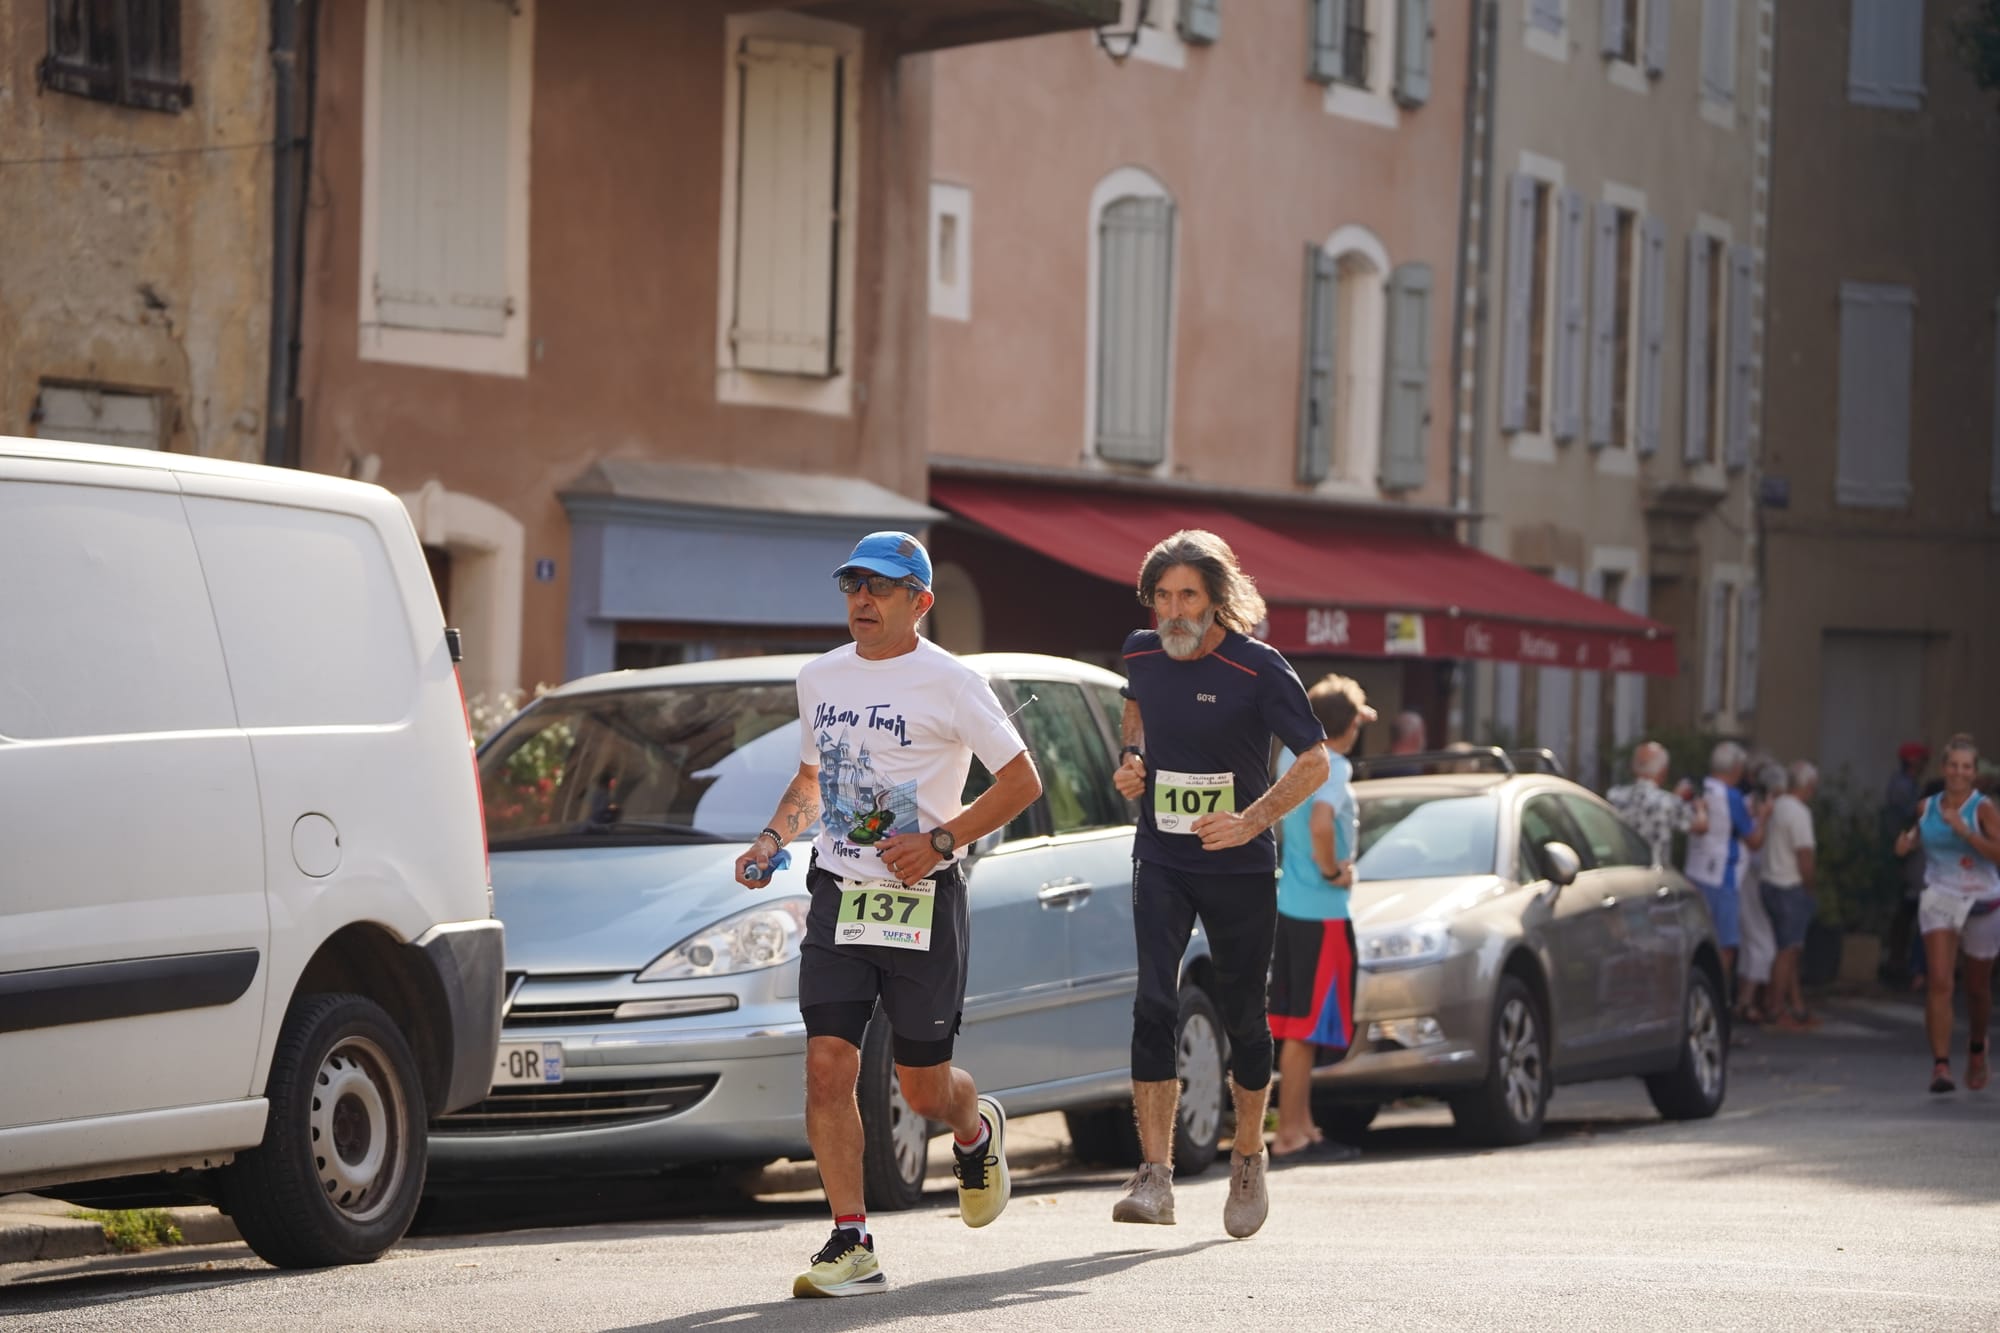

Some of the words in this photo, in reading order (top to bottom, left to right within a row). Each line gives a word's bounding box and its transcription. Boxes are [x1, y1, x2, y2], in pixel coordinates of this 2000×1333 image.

[1306, 608, 1349, 646] BAR
[1196, 693, 1217, 703] GORE
[813, 702, 860, 731] Urban
[1165, 788, 1222, 814] 107
[852, 892, 920, 924] 137
[882, 930, 912, 940] TUFF'S
